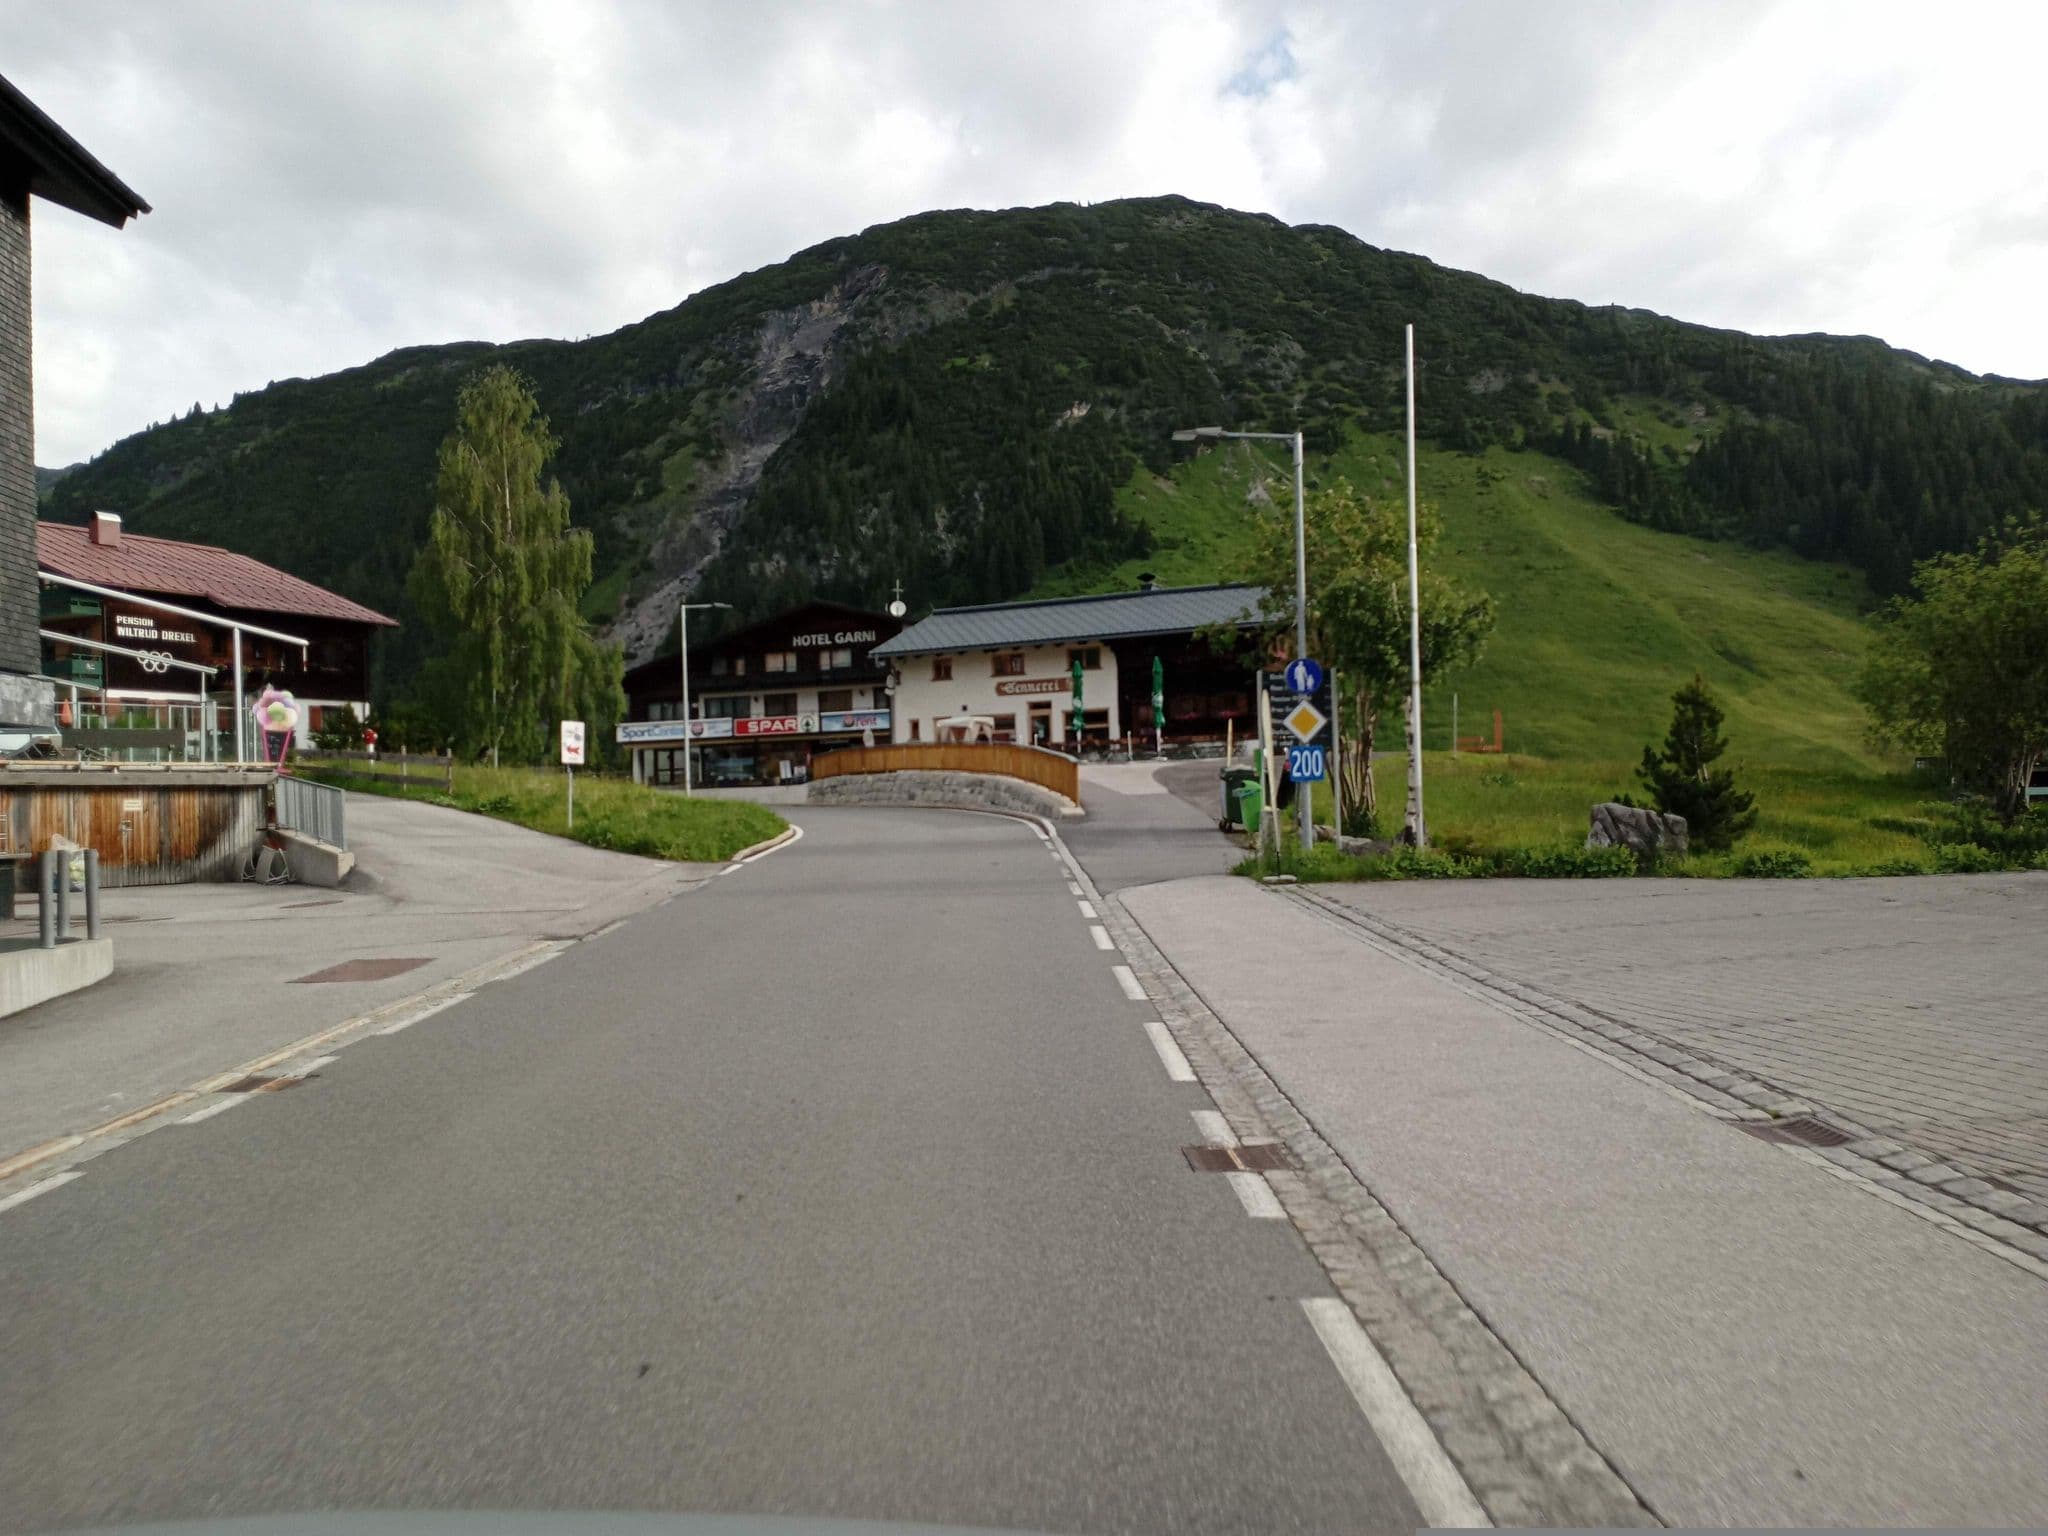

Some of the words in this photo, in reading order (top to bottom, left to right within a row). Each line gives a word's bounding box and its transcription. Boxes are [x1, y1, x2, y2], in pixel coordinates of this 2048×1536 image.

[116, 615, 154, 627] PENSION
[116, 626, 158, 639] WILTRUD
[161, 630, 198, 643] DREXEL
[792, 633, 832, 647] HOTEL
[834, 630, 876, 644] GARNI
[748, 719, 797, 732] SPAR
[1291, 750, 1323, 777] 200
